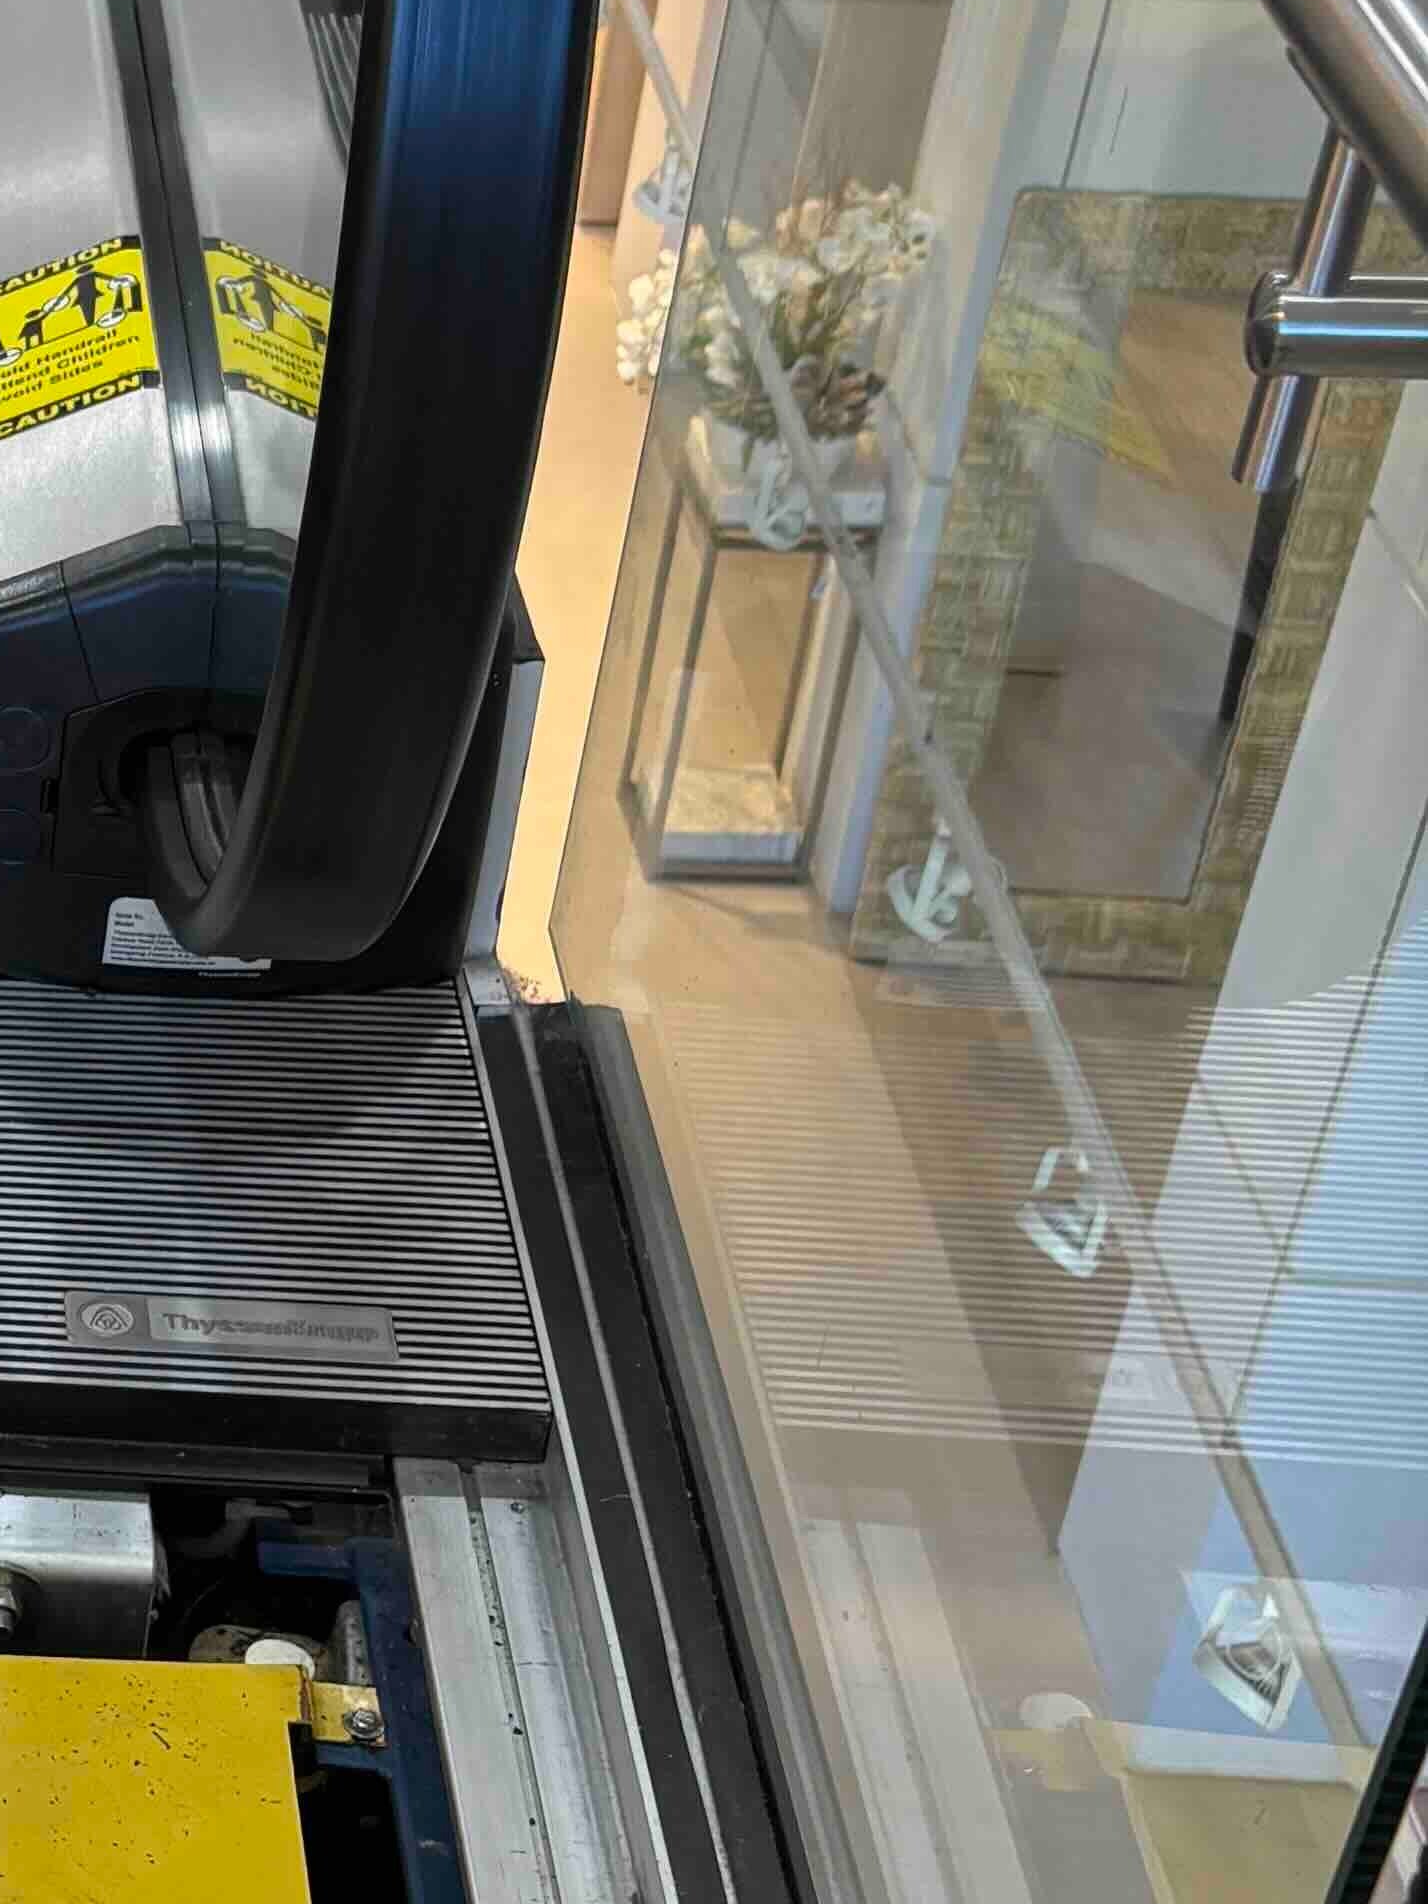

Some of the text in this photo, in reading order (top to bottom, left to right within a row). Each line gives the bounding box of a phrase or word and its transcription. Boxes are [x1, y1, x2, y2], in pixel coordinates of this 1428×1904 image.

[35, 329, 120, 367] Handrail
[43, 335, 141, 379] Children
[49, 359, 104, 385] Sides
